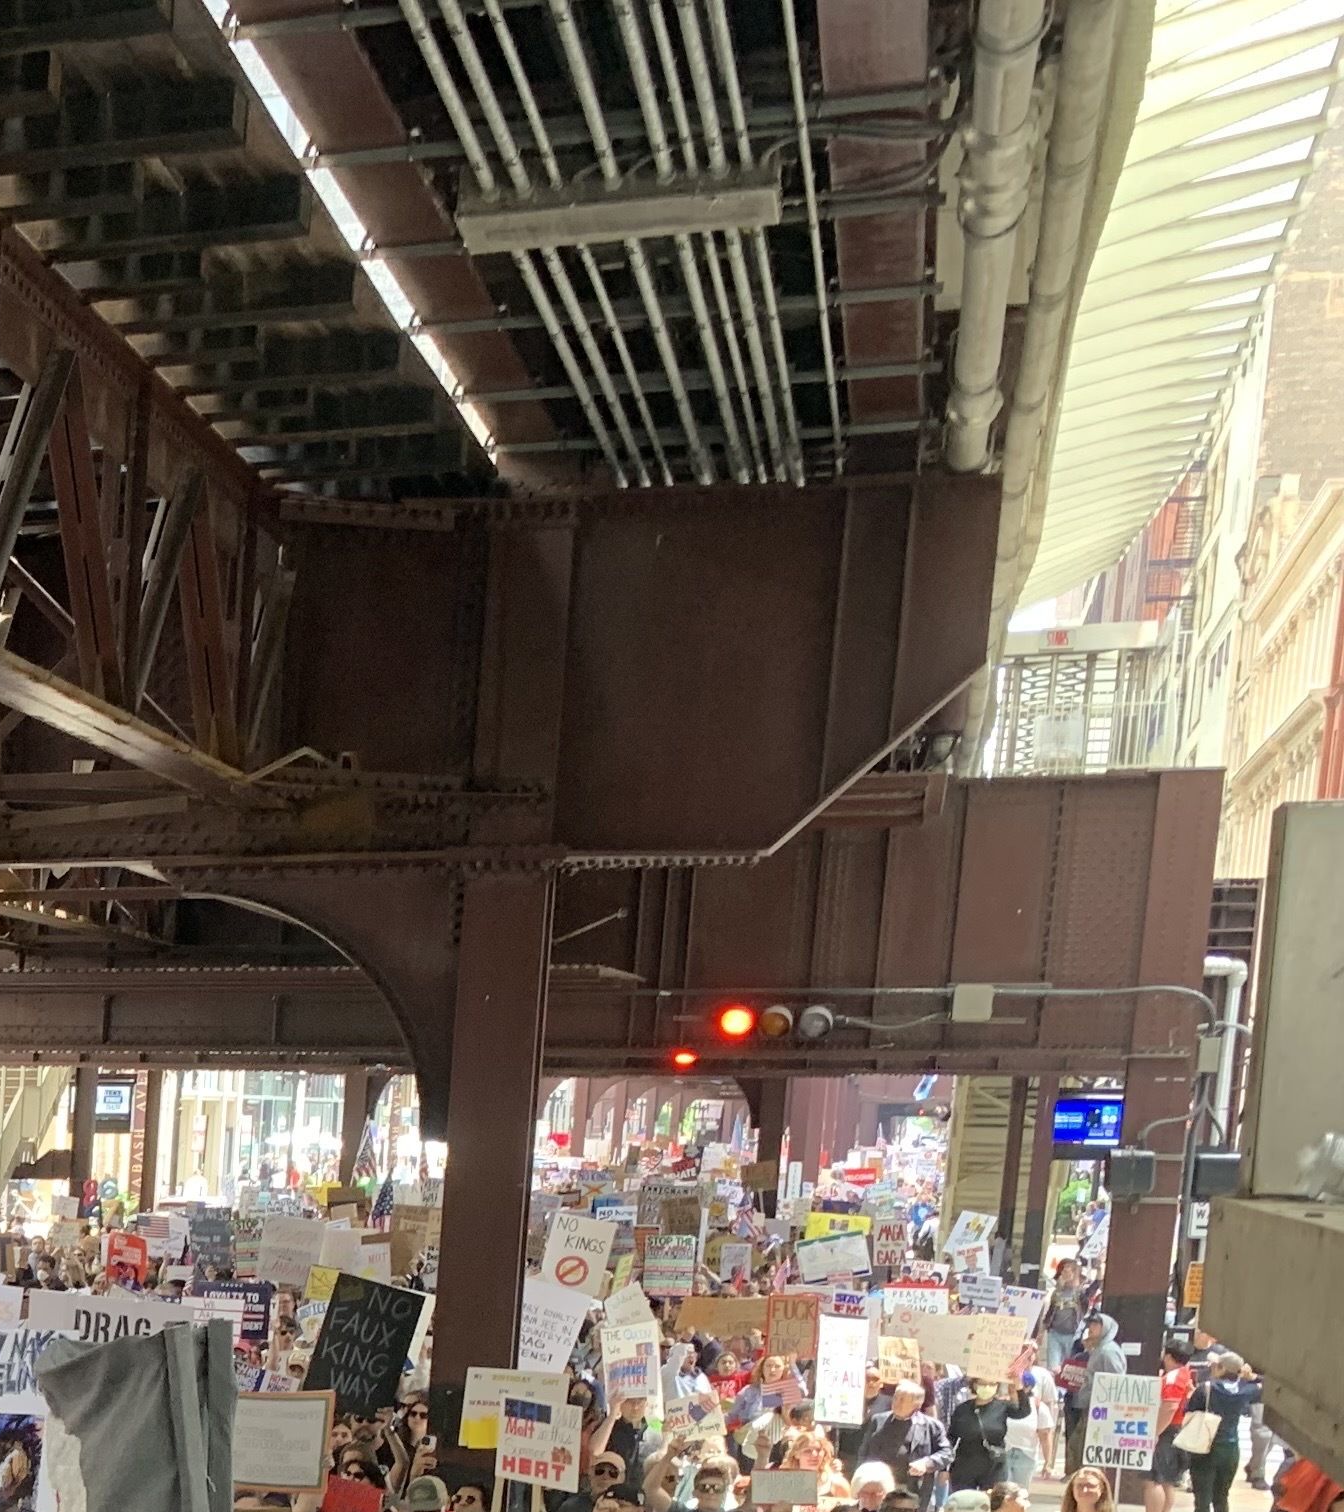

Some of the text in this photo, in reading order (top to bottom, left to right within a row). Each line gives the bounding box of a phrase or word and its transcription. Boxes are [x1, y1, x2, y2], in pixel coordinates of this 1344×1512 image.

[556, 1215, 580, 1232] NO
[877, 1224, 906, 1242] MAGA
[564, 1234, 608, 1255] KINGS
[647, 1236, 694, 1246] STOP THE
[876, 1249, 907, 1266] GAGA
[246, 1291, 260, 1303] TO
[366, 1286, 412, 1321] NO
[771, 1300, 814, 1319] FUCK
[73, 1309, 151, 1342] DRAG
[328, 1305, 398, 1348] FAUX
[771, 1321, 810, 1337] ICE
[320, 1339, 390, 1379] KING
[329, 1369, 379, 1404] WAY
[1096, 1375, 1161, 1407] SHAME
[1114, 1420, 1148, 1436] ICE
[1085, 1445, 1147, 1468] CRONIES
[501, 1455, 565, 1482] HEAT
